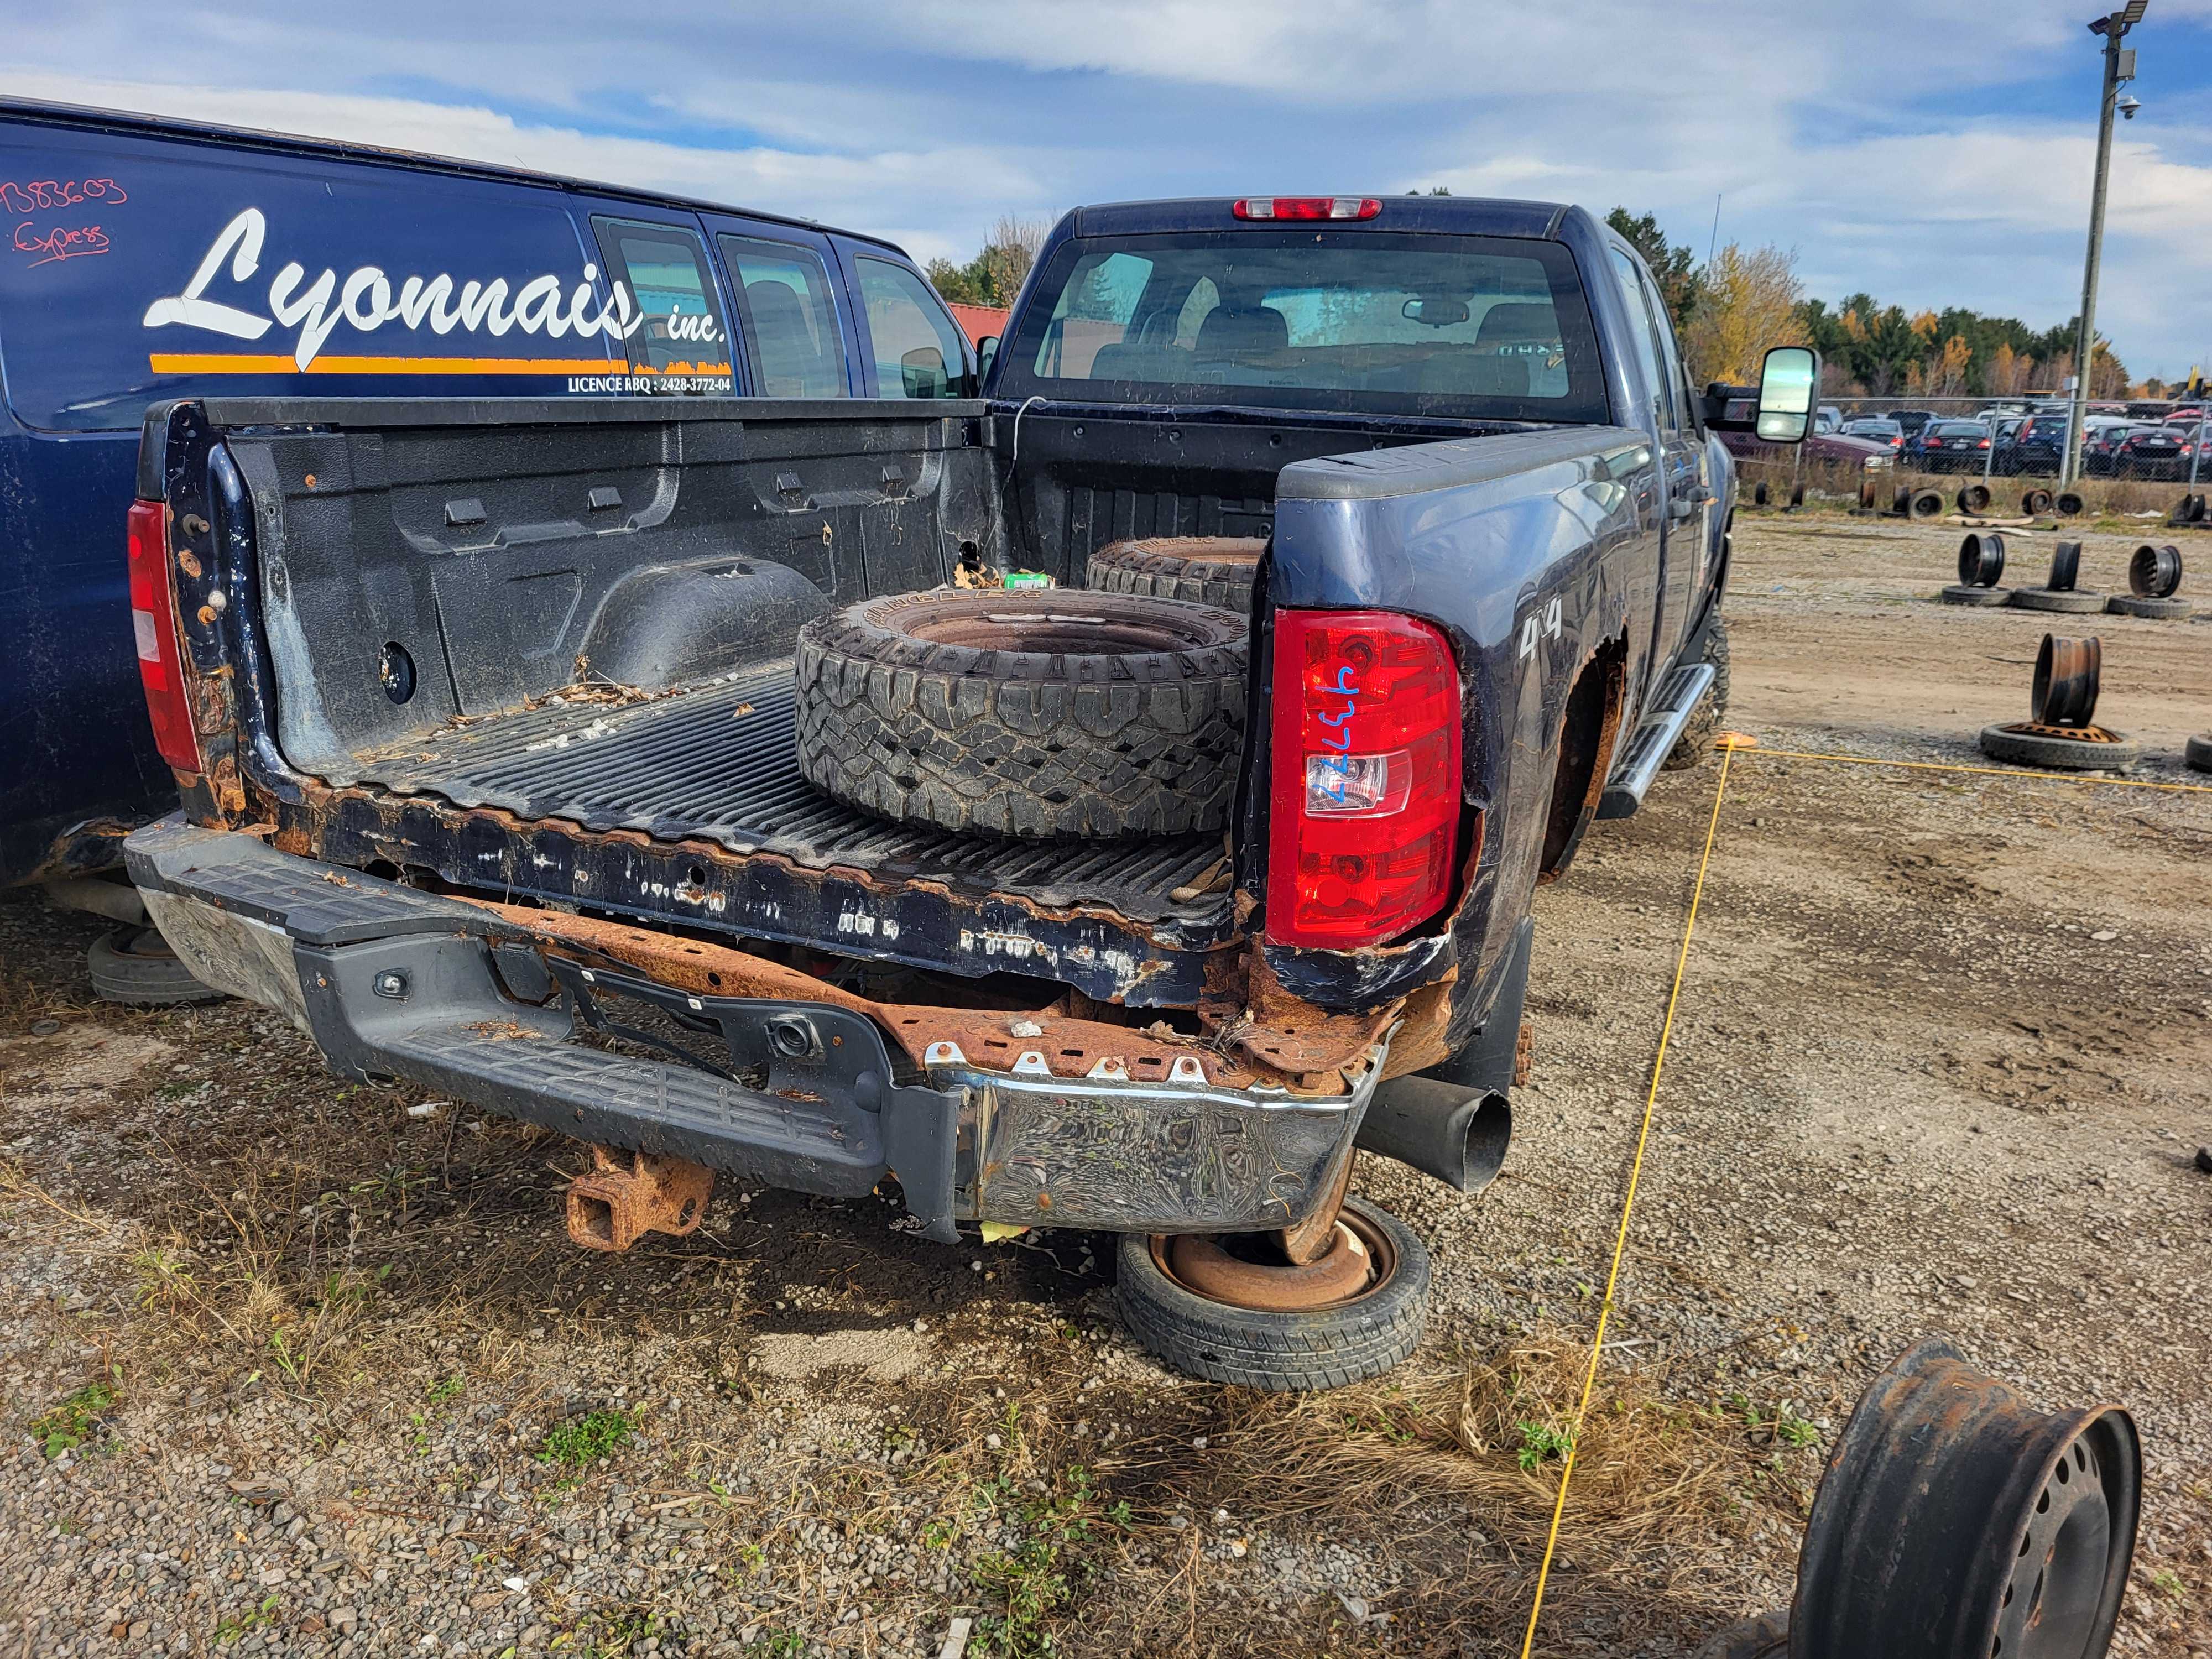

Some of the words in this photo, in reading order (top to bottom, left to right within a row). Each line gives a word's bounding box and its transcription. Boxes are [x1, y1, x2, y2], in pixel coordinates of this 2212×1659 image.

[14, 221, 109, 261] Express
[143, 208, 644, 373] Lyonnais
[667, 304, 725, 342] inc.
[568, 377, 622, 392] LICENCE
[624, 377, 651, 394] RBQ
[660, 377, 731, 392] 2428-3772-04
